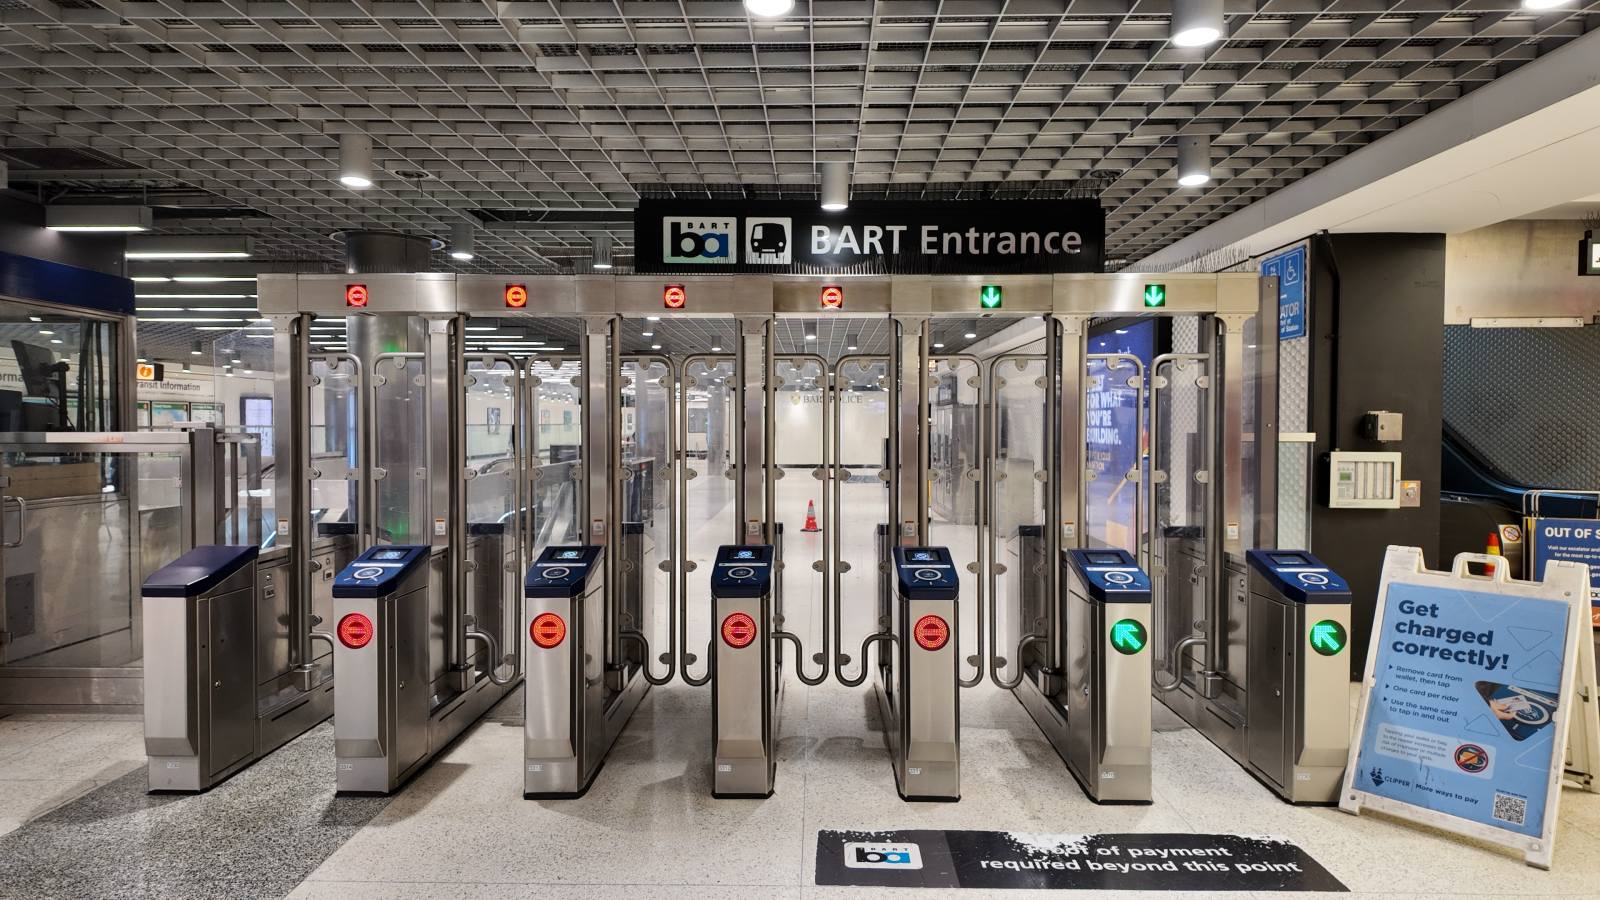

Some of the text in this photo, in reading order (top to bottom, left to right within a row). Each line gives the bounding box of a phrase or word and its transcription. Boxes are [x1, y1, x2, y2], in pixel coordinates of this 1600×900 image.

[687, 222, 730, 230] BART
[811, 225, 1082, 255] BART Entrance
[1280, 302, 1299, 318] ATOR
[136, 380, 201, 392] ransit Information
[1101, 391, 1122, 408] WHAT
[1545, 527, 1571, 538] OUT
[1574, 528, 1592, 538] OF
[1399, 600, 1439, 618] Get
[1395, 619, 1494, 646] charged
[1392, 641, 1509, 671] correctly!
[1395, 673, 1450, 688] wallet, then tap
[1396, 666, 1462, 682] Remove card from
[1393, 685, 1407, 693] One
[1442, 694, 1459, 702] rider
[1419, 705, 1438, 713] same
[1421, 712, 1435, 720] and
[1384, 728, 1403, 737] Tapping
[1414, 741, 1437, 749] increases
[1384, 776, 1410, 787] CLIPPER
[1415, 783, 1433, 792] More
[1435, 789, 1453, 798] ways
[1465, 796, 1479, 804] pay
[1027, 845, 1233, 858] oof of payment
[980, 859, 1303, 874] required beyond this point
